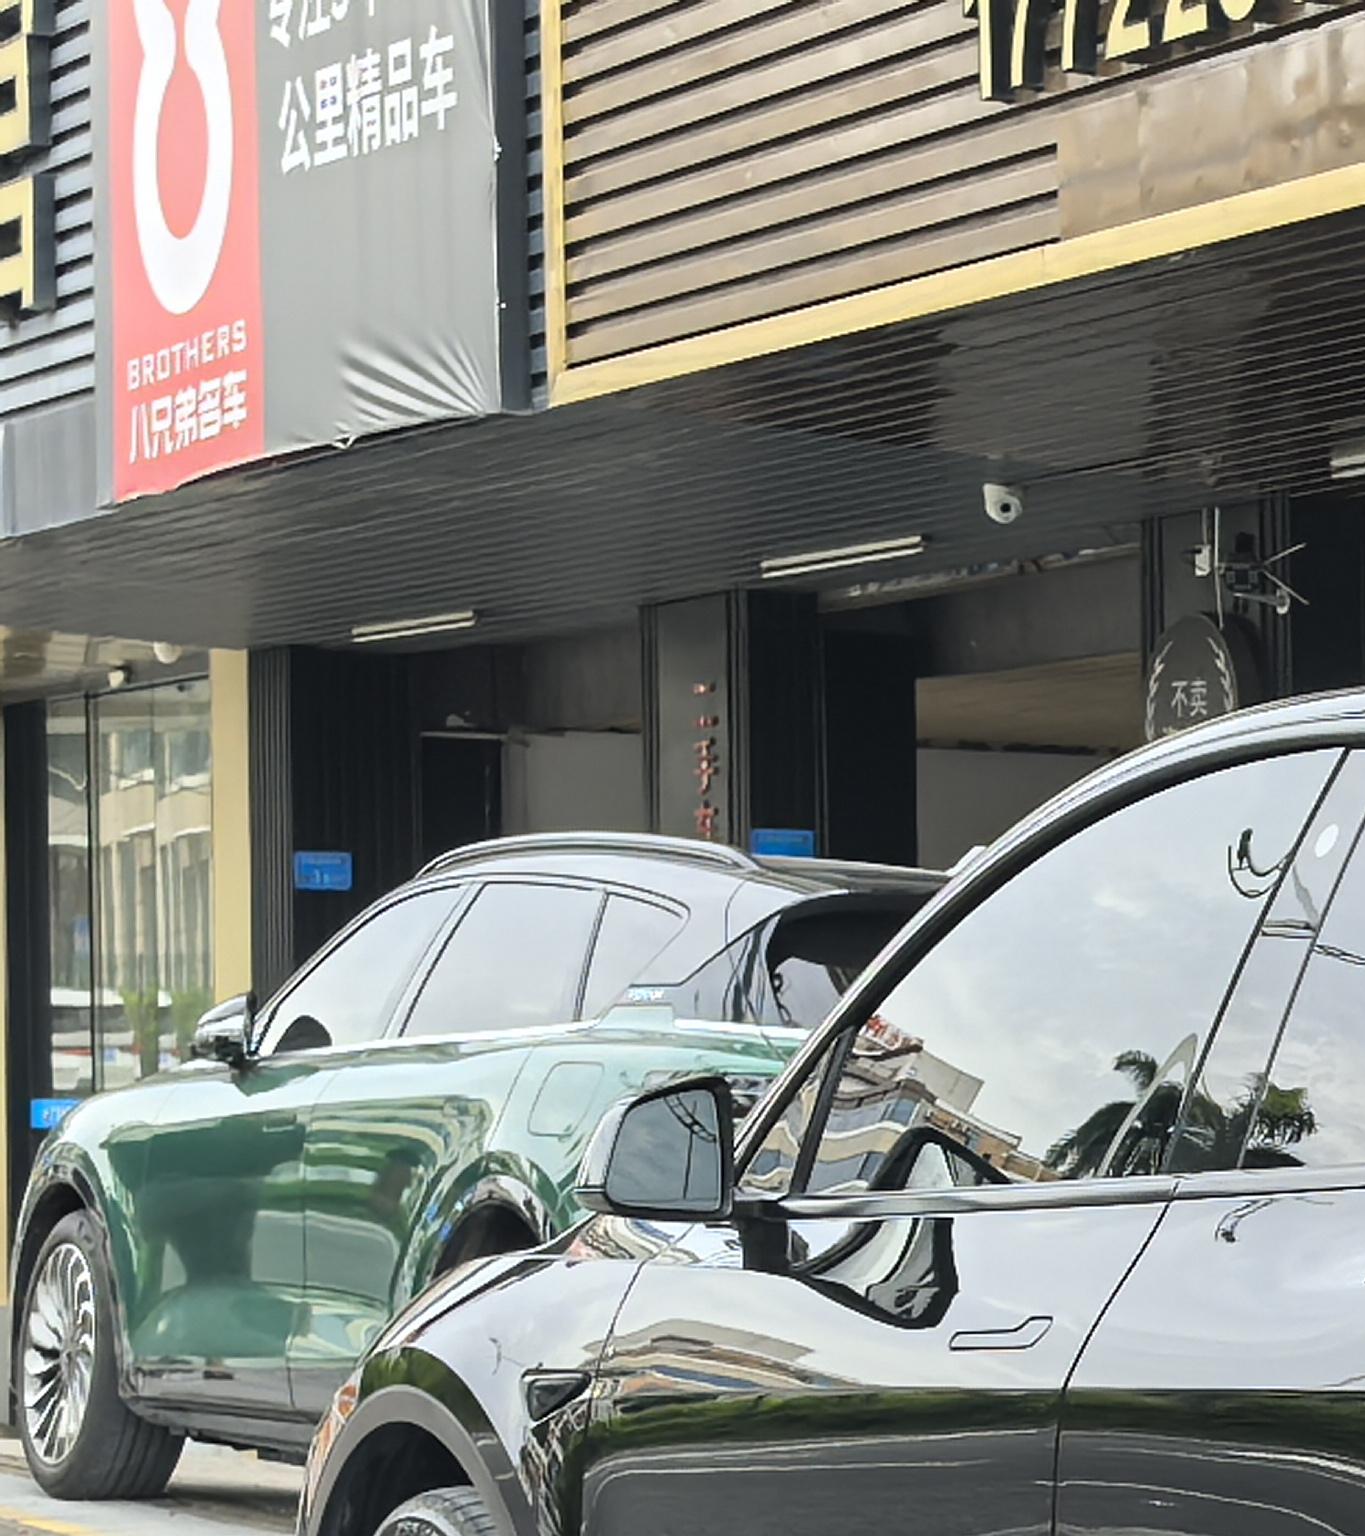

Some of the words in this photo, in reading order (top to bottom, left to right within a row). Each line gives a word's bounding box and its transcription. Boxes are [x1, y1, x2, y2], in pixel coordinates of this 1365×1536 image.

[278, 24, 458, 175] 公里精品车
[127, 318, 247, 391] BROTHERS
[128, 368, 248, 464] 八兄弟名车
